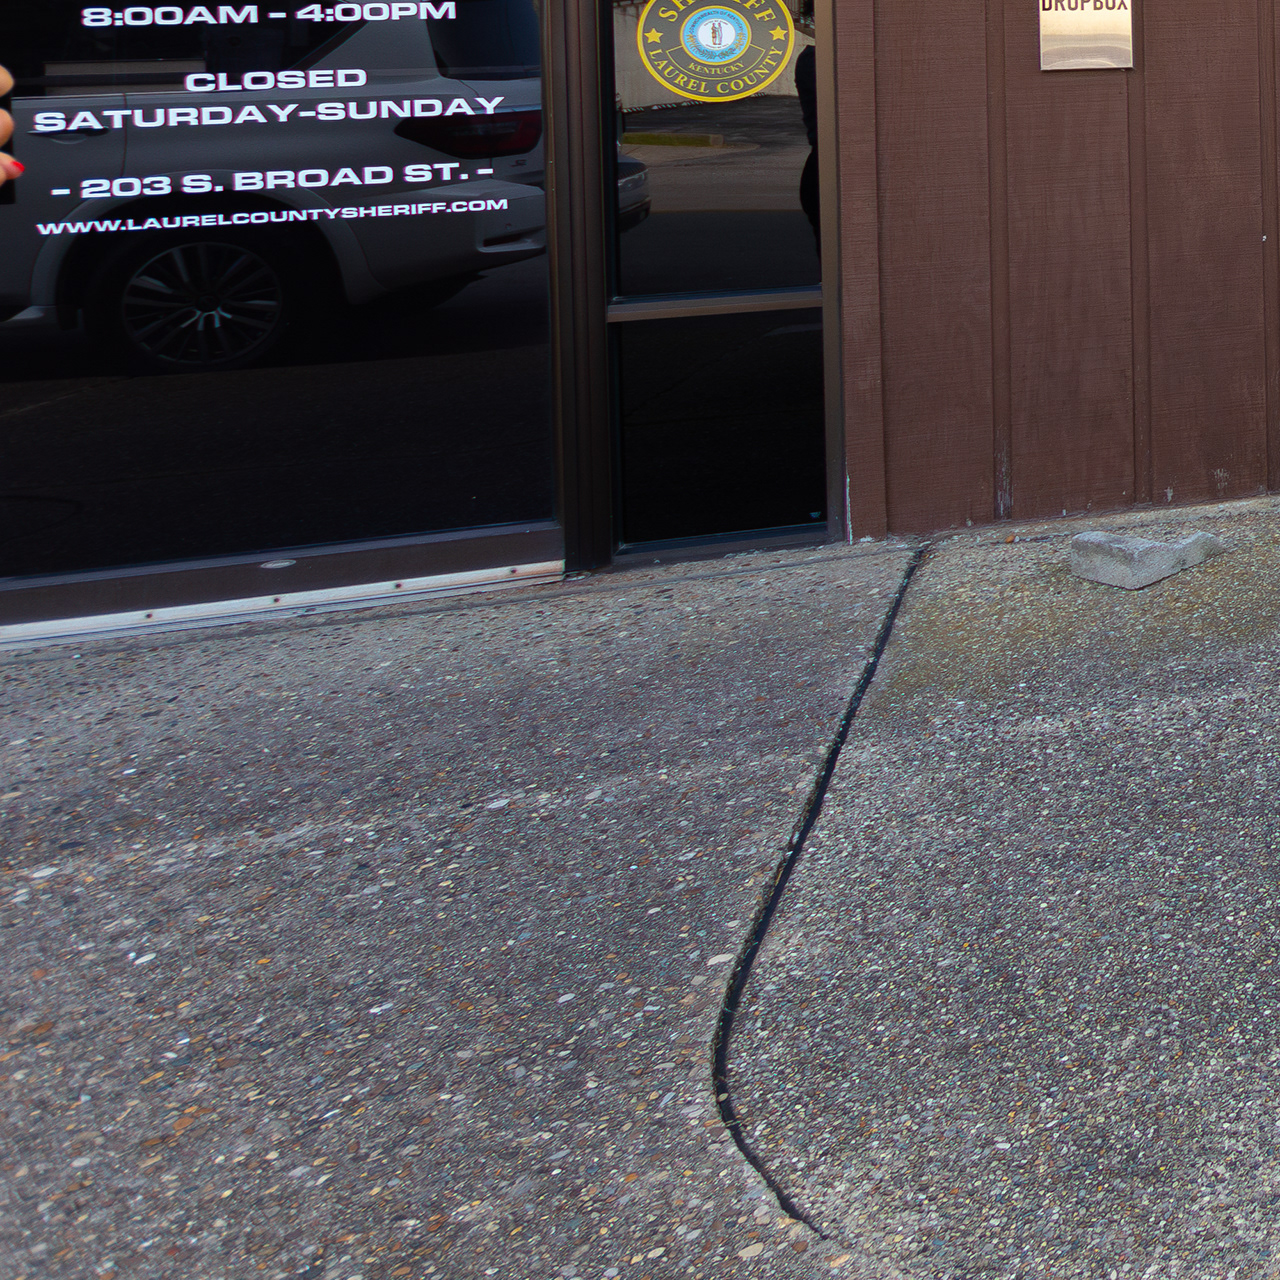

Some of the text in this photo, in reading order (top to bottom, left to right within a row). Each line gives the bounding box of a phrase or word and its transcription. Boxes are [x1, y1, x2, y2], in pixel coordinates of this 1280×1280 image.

[81, 5, 258, 26] 8:00AM
[296, 1, 456, 22] 4:00PM
[184, 68, 366, 92] CLOSED
[649, 46, 783, 93] LAUREL COUNTY
[688, 62, 745, 75] KENTUCKY
[34, 96, 505, 132] SATURDAY-SUNDAY
[80, 177, 172, 198] 203
[181, 173, 224, 194] S.
[234, 165, 394, 191] BROAD
[404, 162, 470, 182] ST.
[36, 199, 508, 235] WWW.LAURELCOUNTYSHERIFF.COM
